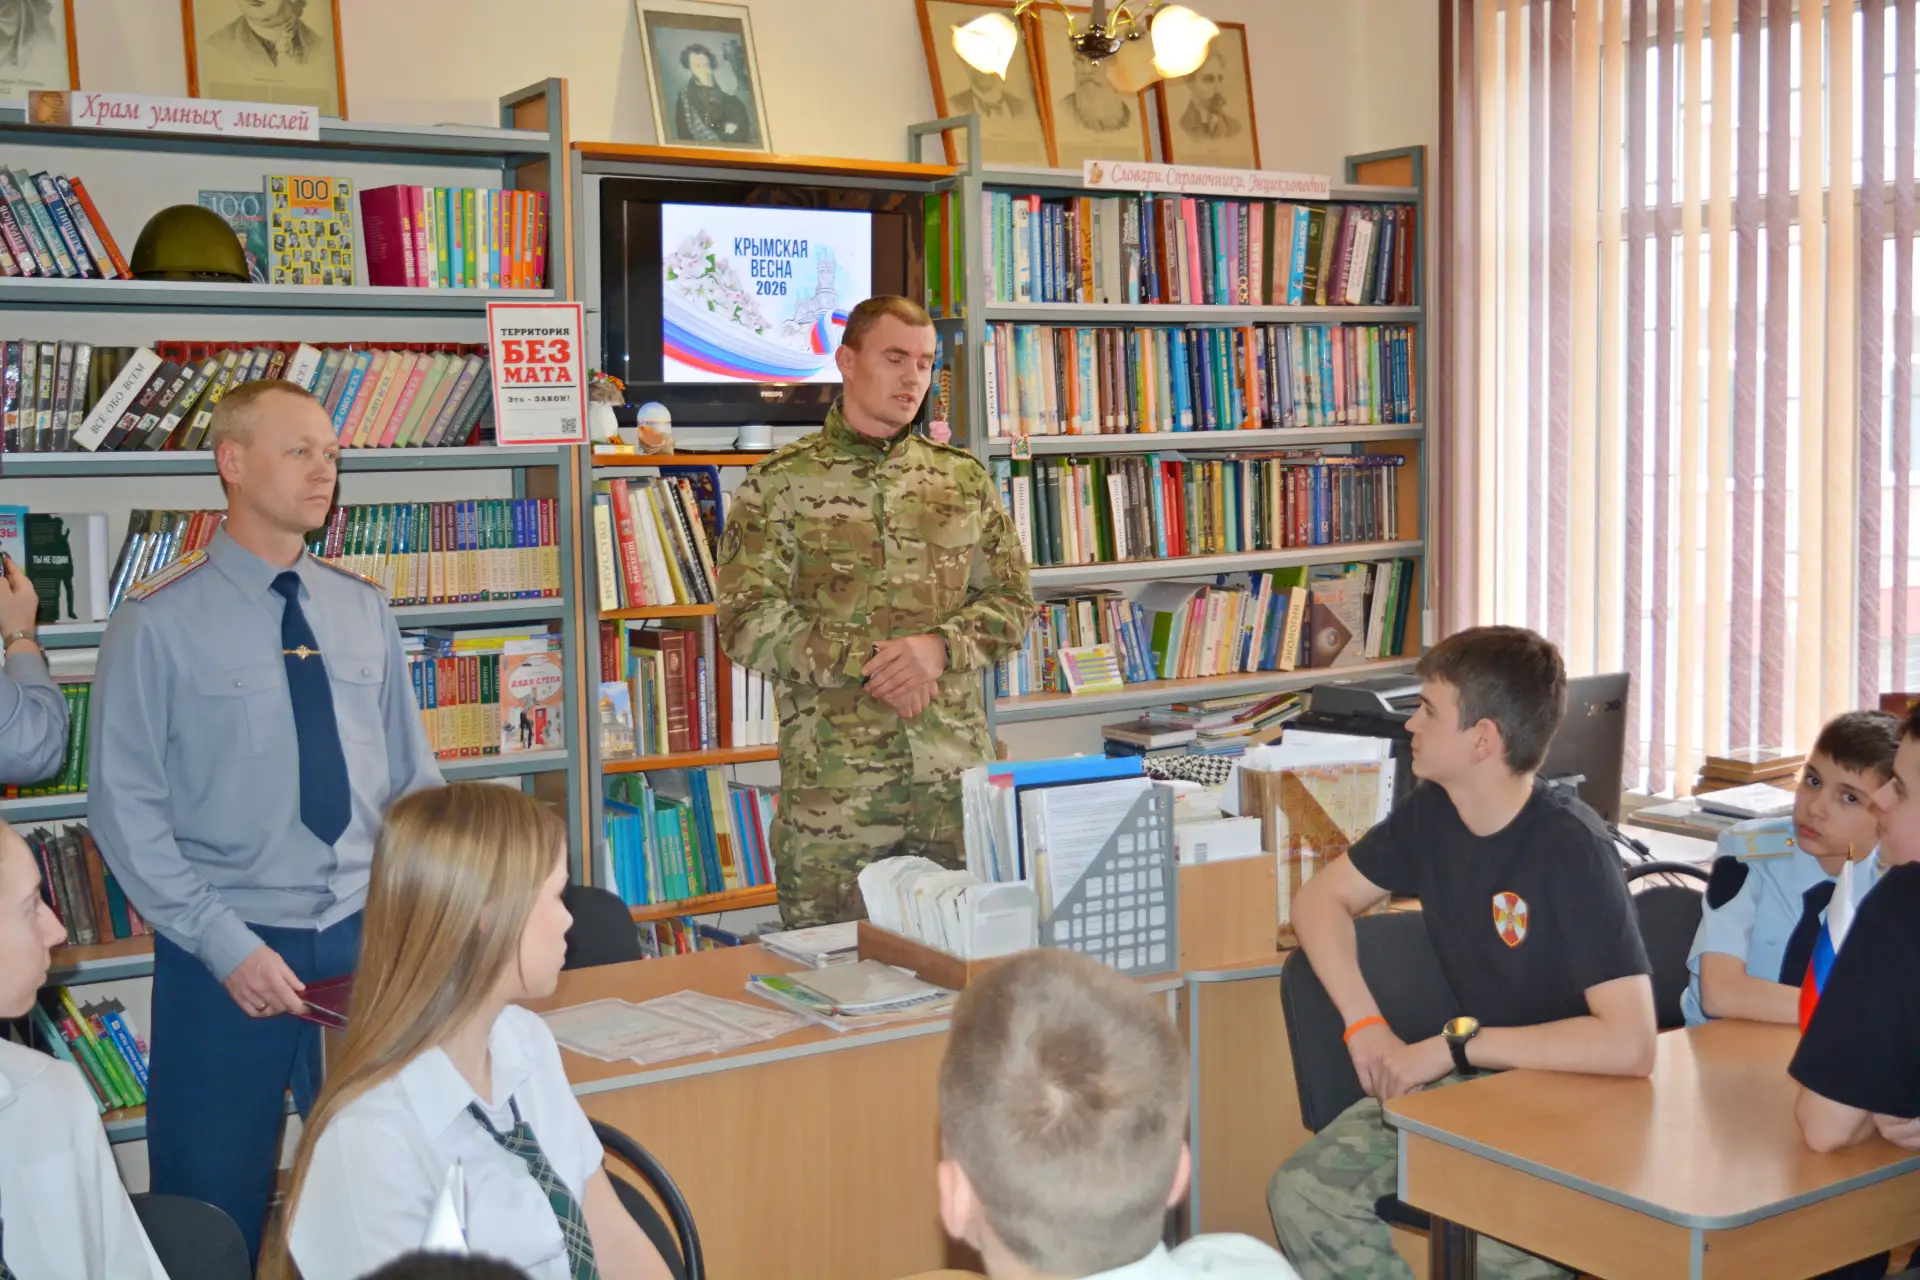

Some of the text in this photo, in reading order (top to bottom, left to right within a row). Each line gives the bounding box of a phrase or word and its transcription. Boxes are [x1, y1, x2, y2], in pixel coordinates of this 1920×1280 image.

[80, 94, 310, 131] Храм умных мыслей
[293, 179, 329, 200] 100
[1111, 164, 1328, 195] Словари. Справочники. Энциклопедии
[212, 196, 259, 218] 100
[734, 237, 808, 258] КРЫМСКАЯ
[751, 259, 792, 278] ВЕСНА
[756, 281, 787, 296] 2026
[501, 328, 570, 336] ТЕРРИТОРИЯ
[502, 339, 571, 364] БЕЗ
[503, 366, 572, 383] МАТА
[33, 555, 68, 565] ТЫ НЕ ОДИН
[627, 541, 640, 584] ШЕДЕВРЫ
[1284, 604, 1300, 662] ЭКОЛОГИЯ
